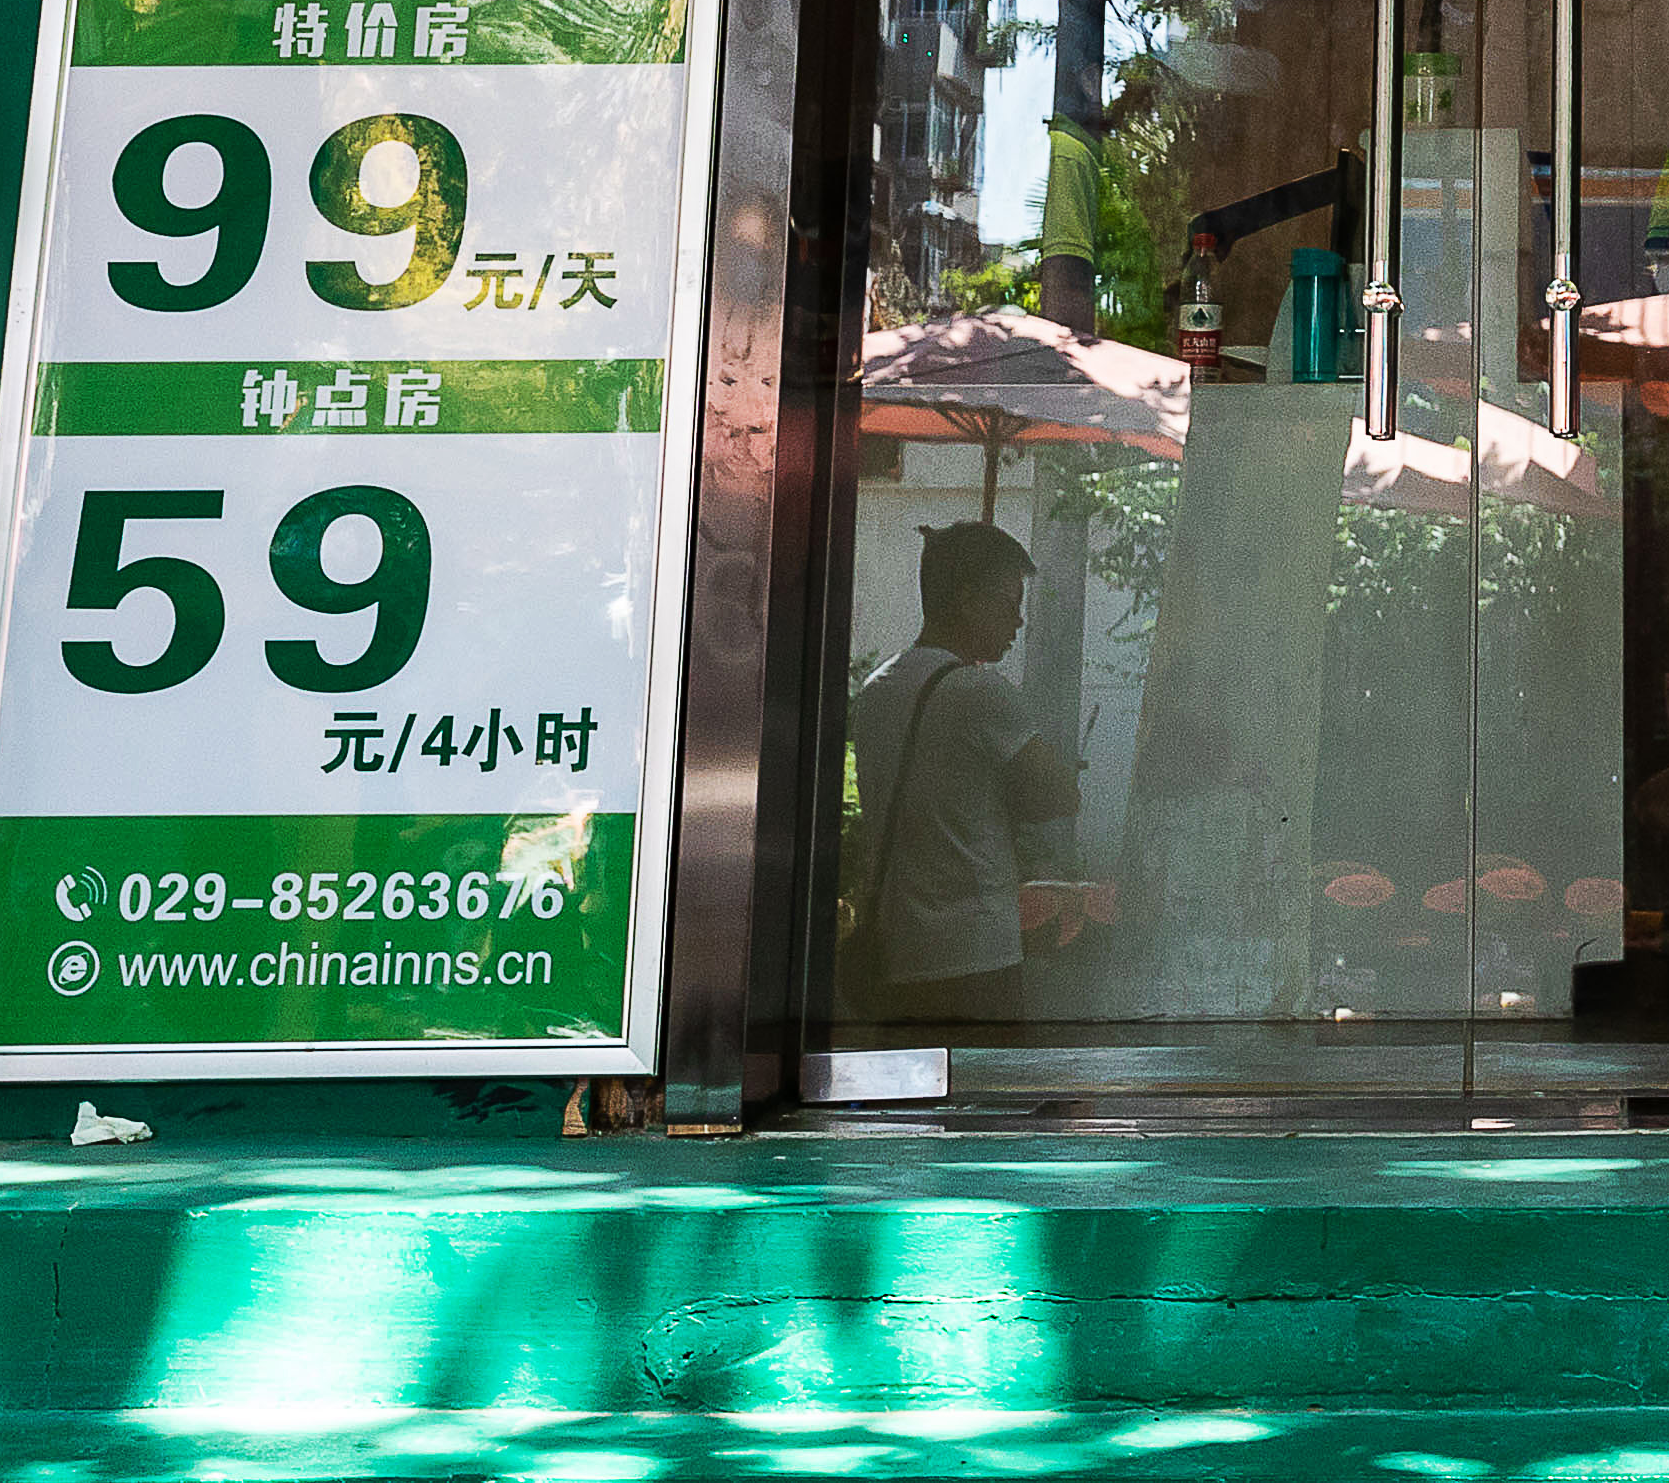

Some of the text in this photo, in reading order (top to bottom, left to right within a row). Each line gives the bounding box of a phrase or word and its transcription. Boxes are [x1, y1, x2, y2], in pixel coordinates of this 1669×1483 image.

[271, 1, 470, 59] 特价房
[106, 112, 619, 313] 99 元/天
[240, 368, 442, 428] 钟点房
[60, 484, 433, 695] 59
[320, 707, 599, 774] 元/4小时
[119, 871, 564, 922] 029-85263676
[118, 942, 553, 988] www.chinainns.cn
